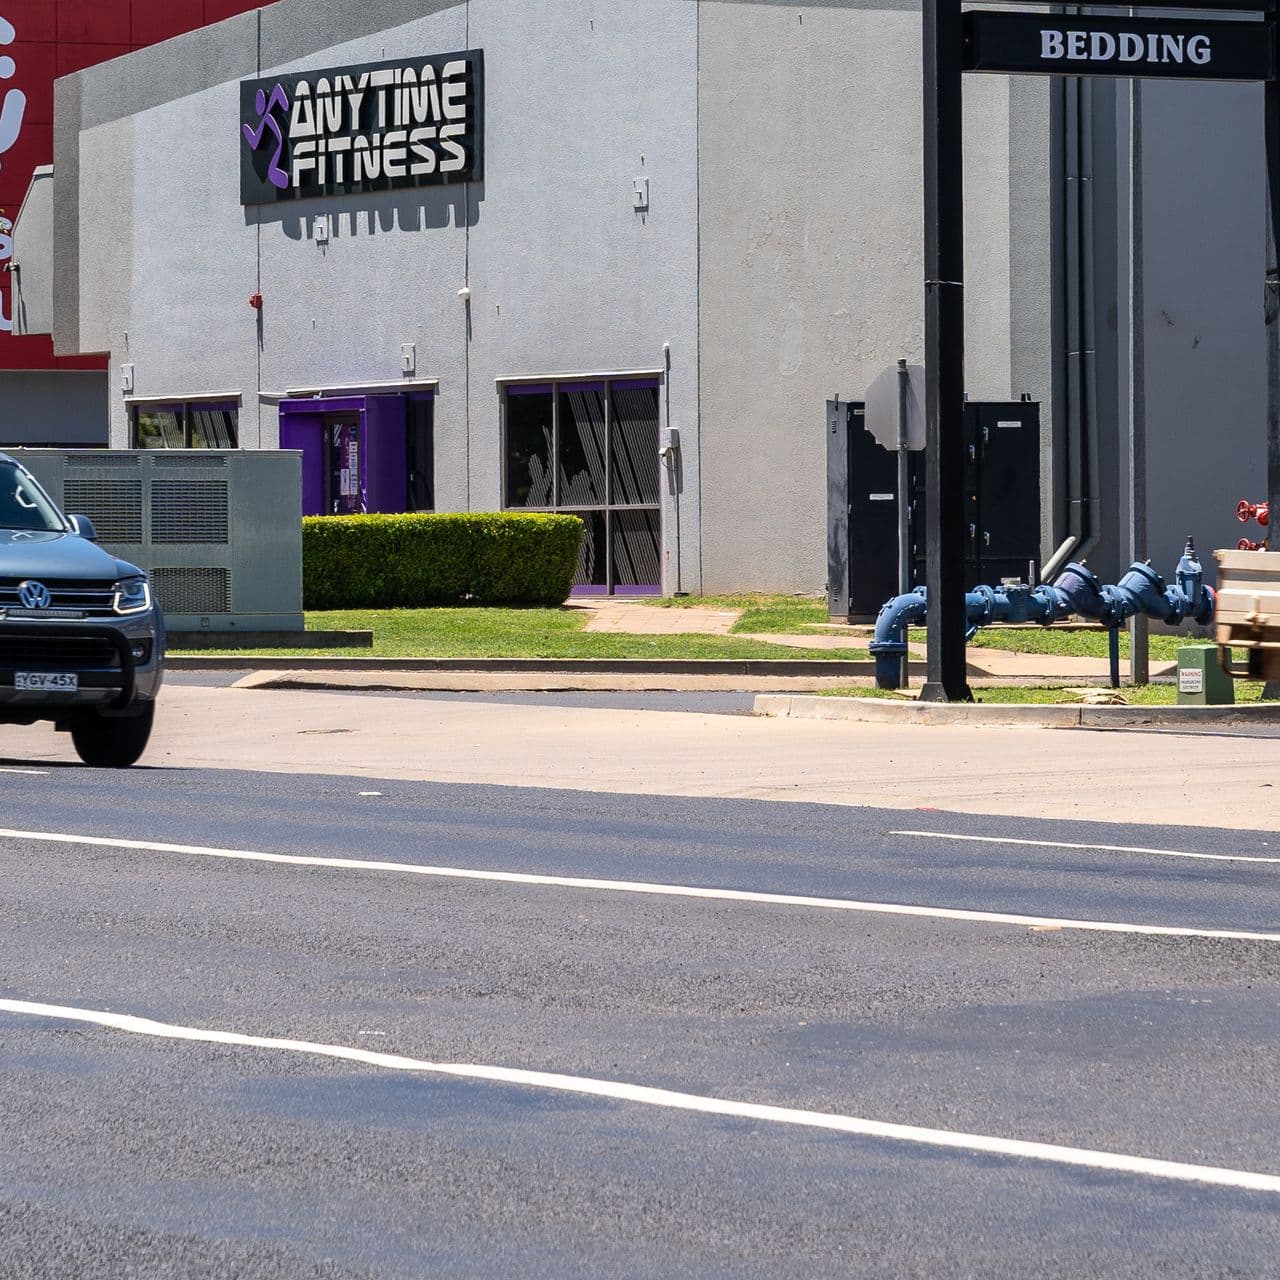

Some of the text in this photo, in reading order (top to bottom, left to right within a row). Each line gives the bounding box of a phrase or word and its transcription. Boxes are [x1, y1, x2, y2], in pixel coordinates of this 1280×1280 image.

[1040, 29, 1212, 65] BEDDING
[288, 60, 466, 138] ANYTIME
[292, 123, 466, 187] FITNESS
